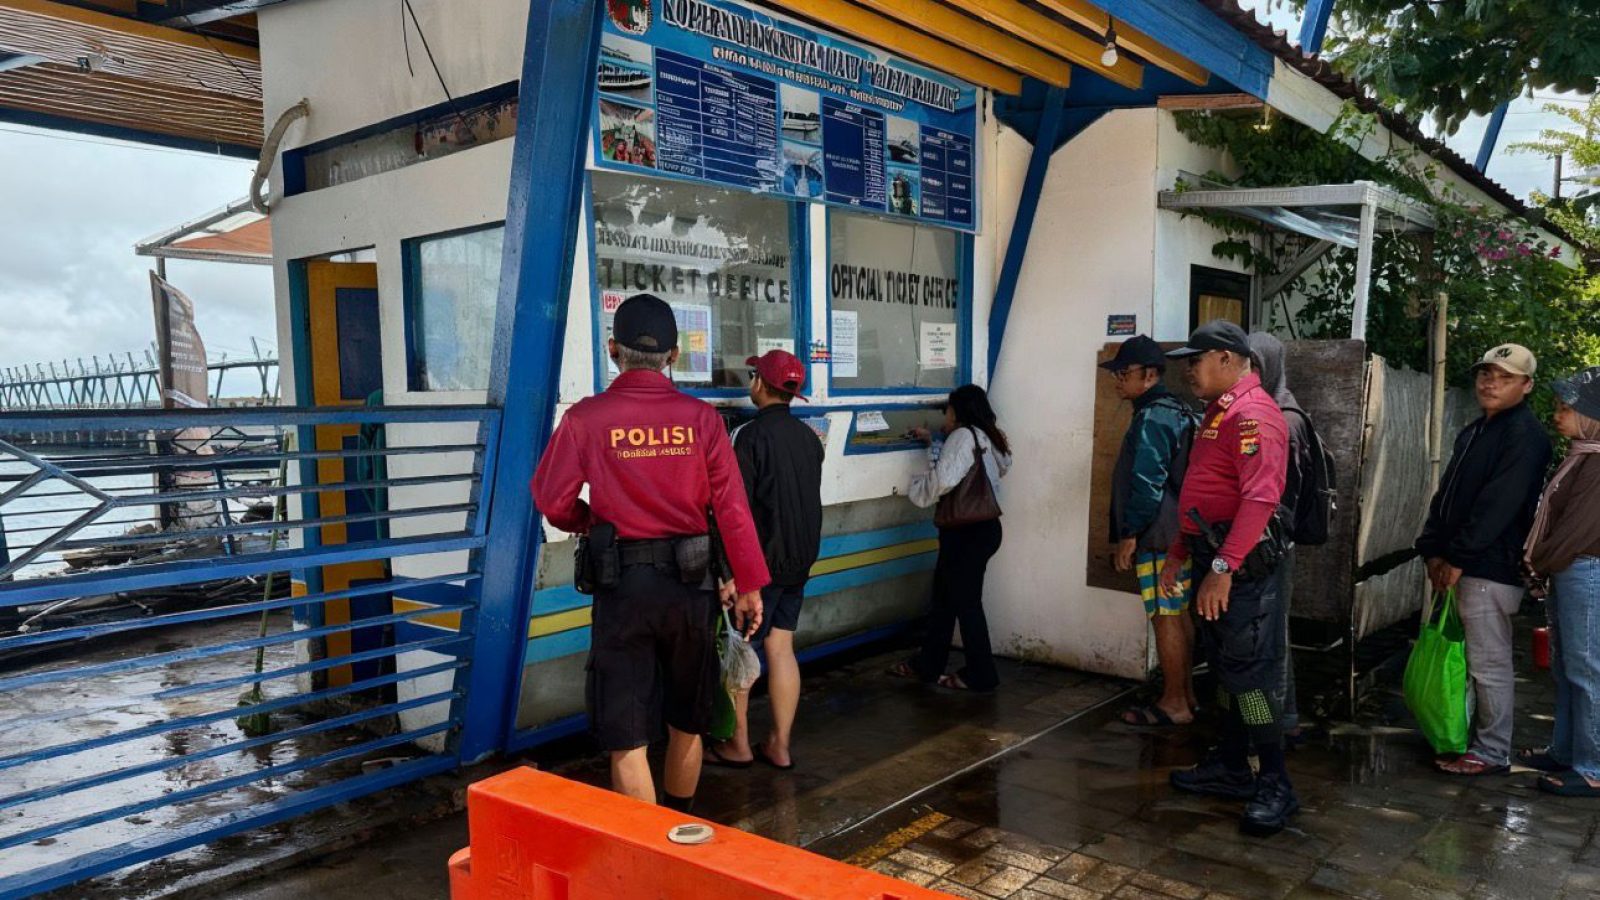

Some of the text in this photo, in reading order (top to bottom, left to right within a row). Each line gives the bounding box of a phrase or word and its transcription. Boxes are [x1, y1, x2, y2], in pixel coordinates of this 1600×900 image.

[601, 258, 701, 297] TICKET
[831, 263, 959, 309] OFFICIAL TICKET OFFICE
[610, 426, 695, 448] POLISI
